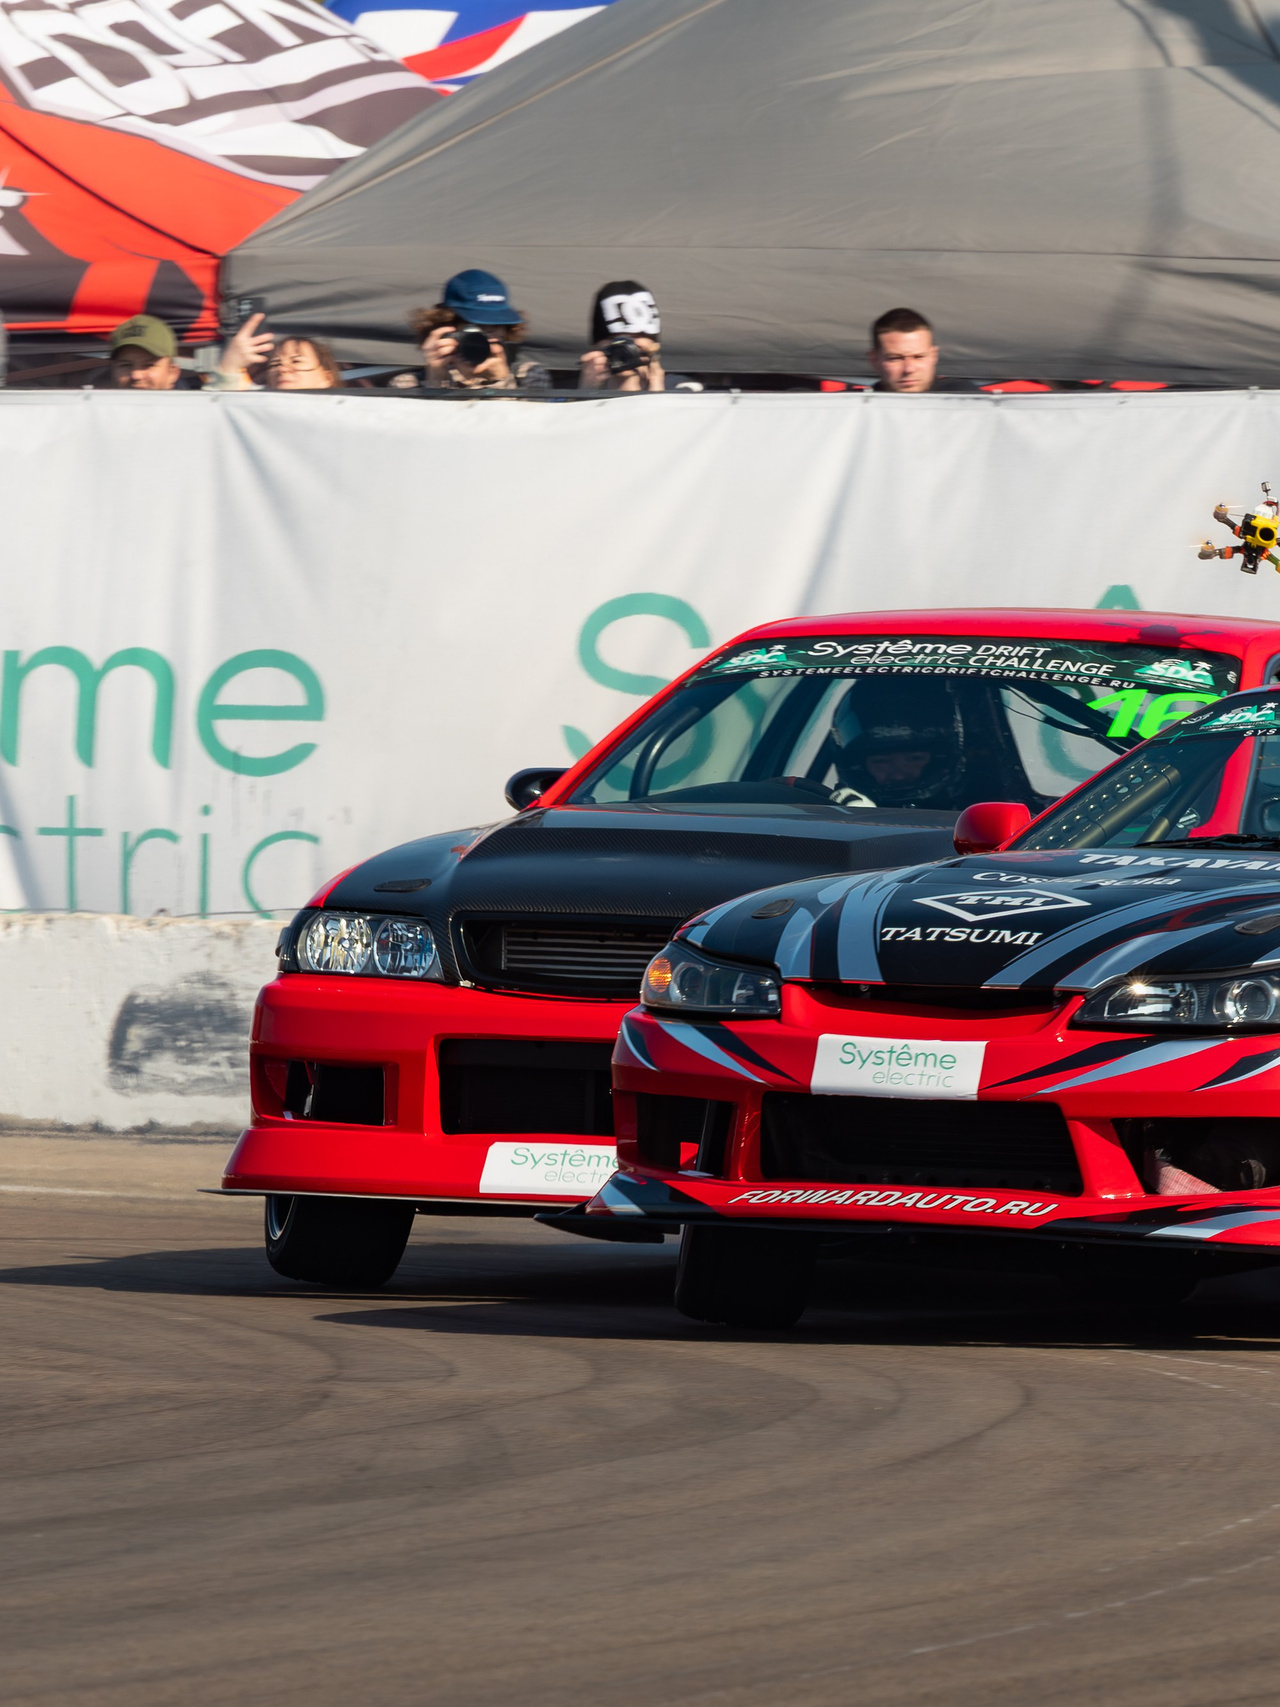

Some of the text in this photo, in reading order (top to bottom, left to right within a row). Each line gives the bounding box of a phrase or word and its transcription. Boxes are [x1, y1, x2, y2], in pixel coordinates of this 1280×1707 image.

[729, 651, 783, 666] SDC
[975, 643, 1053, 659] DRIFT
[849, 653, 1117, 676] electric CHALLENGE
[1144, 664, 1207, 682] SDC
[758, 665, 1136, 690] SYSTEMEELECTRICDRIFTCHALLENGE.RU
[1212, 709, 1273, 725] SDC
[954, 895, 1054, 907] TMI
[881, 927, 1043, 945] TATSUMI
[872, 1067, 955, 1088] electric
[544, 1167, 611, 1184] electr
[728, 1190, 1058, 1216] FORWARDAUTO.RU
